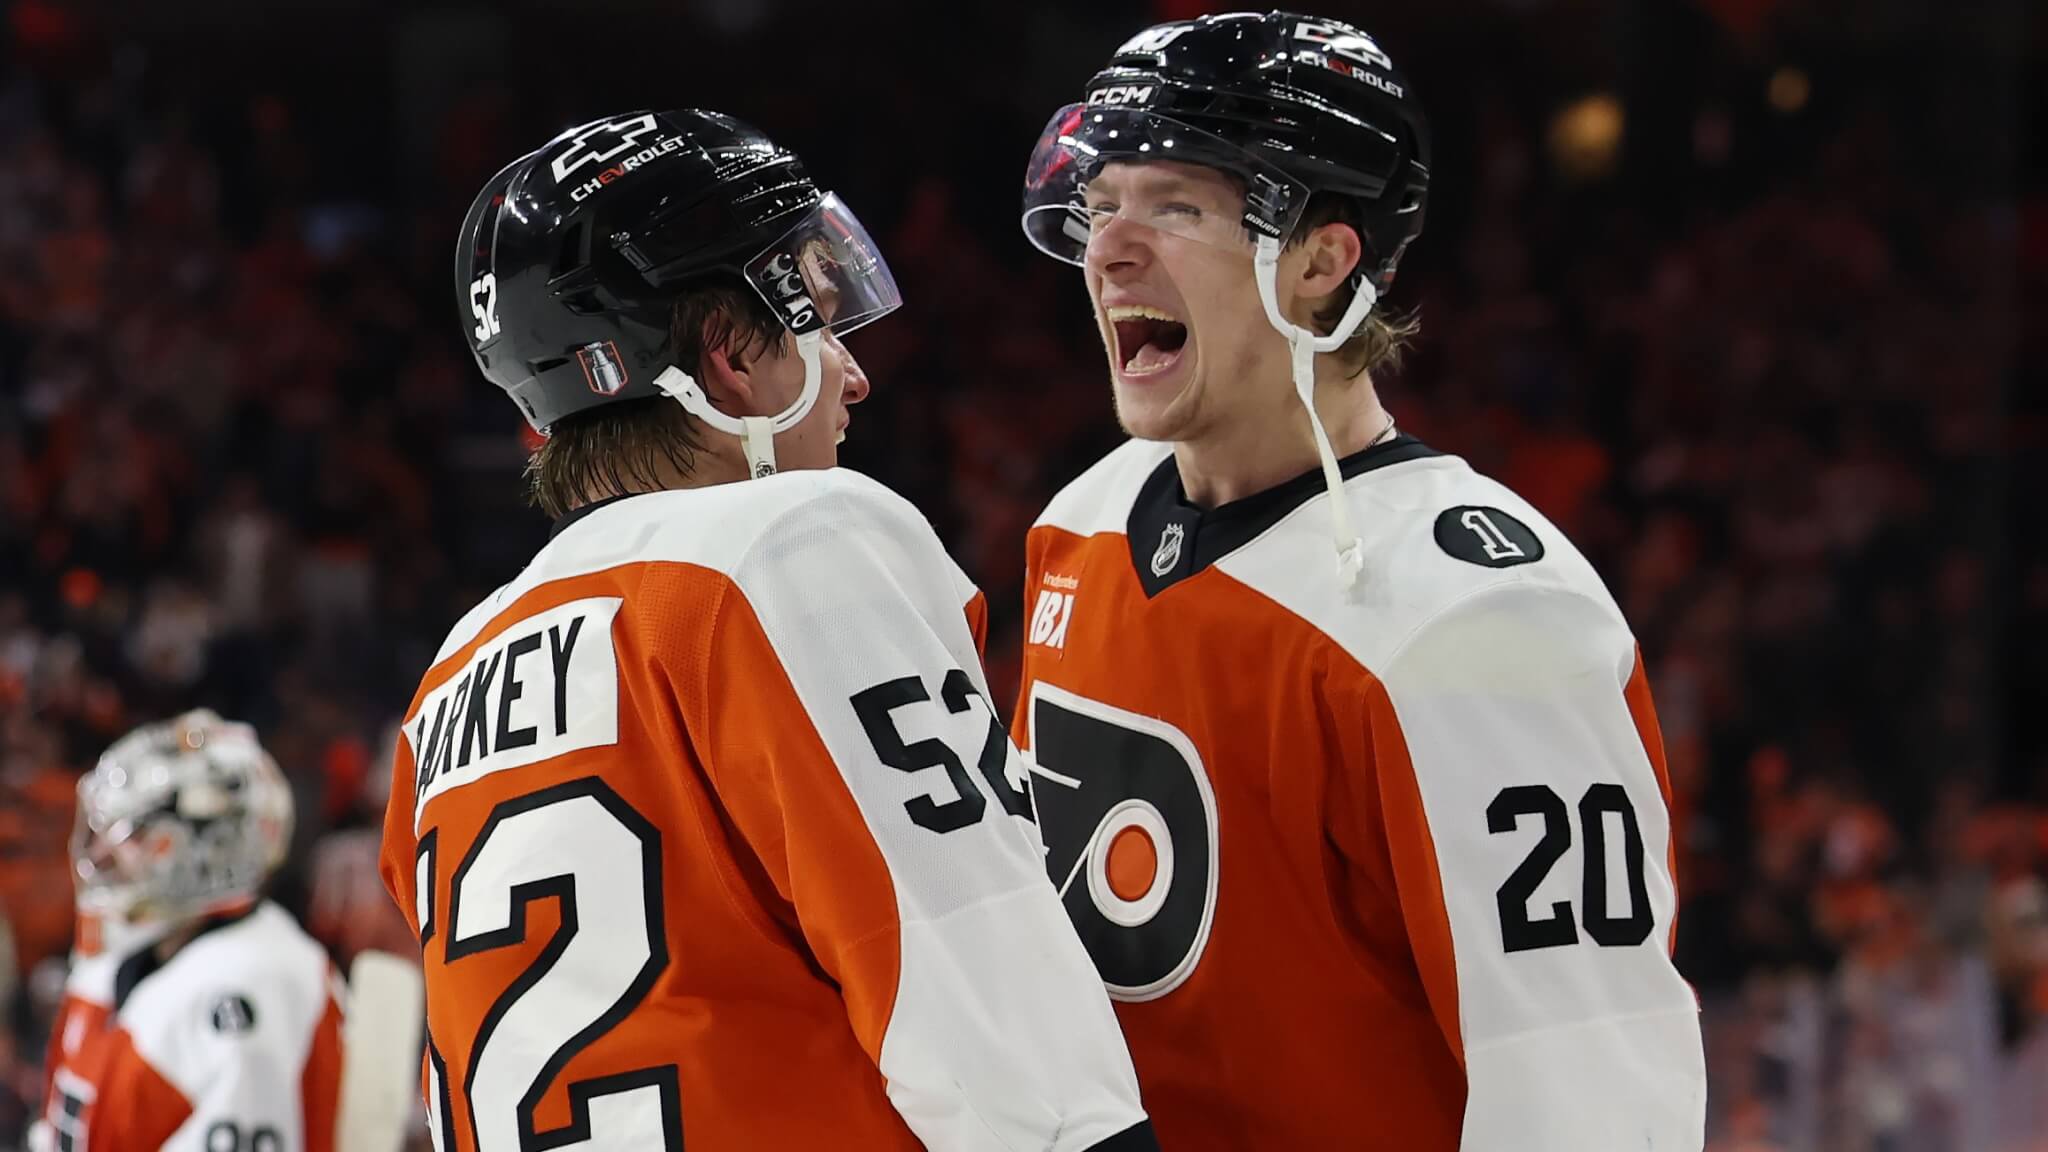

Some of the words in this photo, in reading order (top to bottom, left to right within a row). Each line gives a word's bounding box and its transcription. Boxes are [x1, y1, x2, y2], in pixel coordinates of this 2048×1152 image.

[1088, 86, 1153, 106] CCM
[570, 136, 685, 202] CHEVROLET
[470, 272, 501, 342] 52
[1461, 509, 1525, 562] 1
[849, 668, 1037, 834] 52
[1486, 783, 1655, 953] 20
[416, 774, 685, 1152] 2
